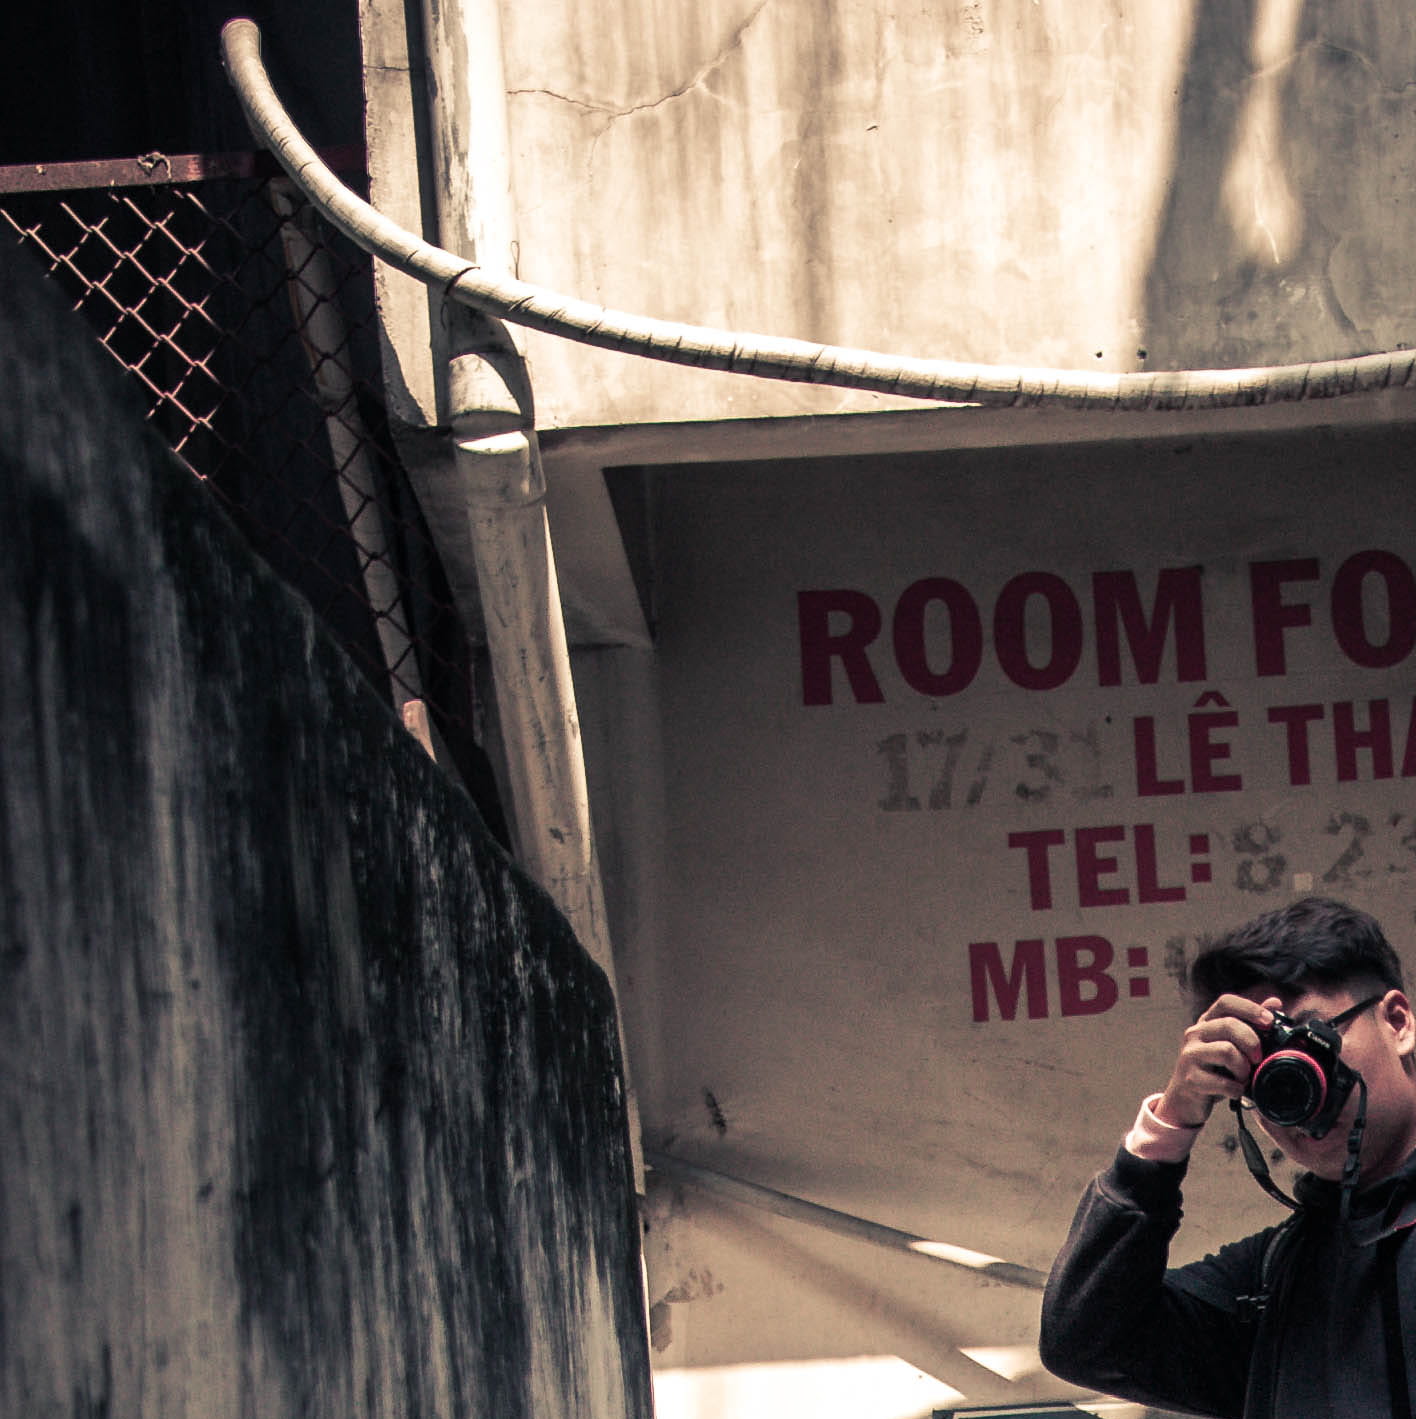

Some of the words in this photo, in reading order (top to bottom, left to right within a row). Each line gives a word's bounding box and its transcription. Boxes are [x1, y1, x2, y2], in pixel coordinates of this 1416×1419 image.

[796, 565, 1208, 707] ROOM
[1133, 690, 1243, 798] LÊ
[1008, 823, 1212, 912] TEL:
[968, 934, 1151, 1023] MB:
